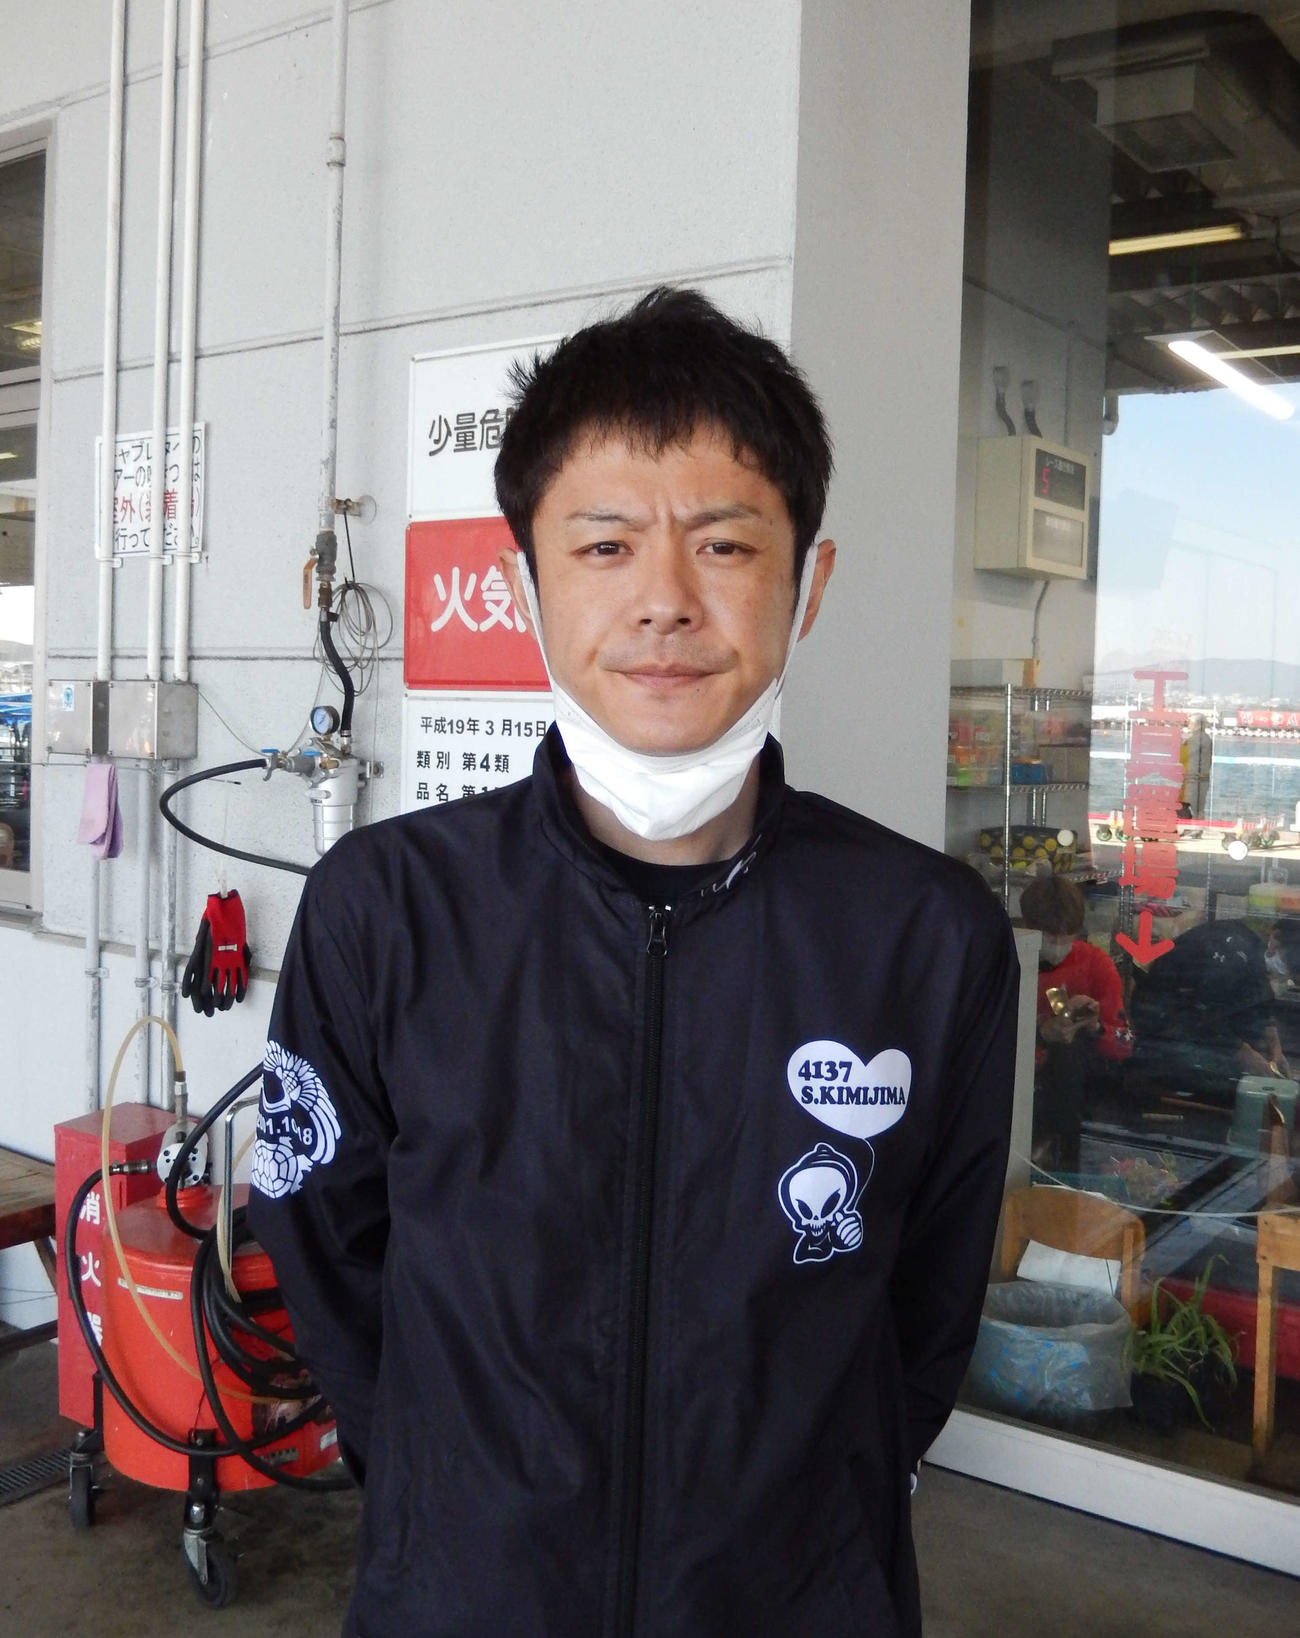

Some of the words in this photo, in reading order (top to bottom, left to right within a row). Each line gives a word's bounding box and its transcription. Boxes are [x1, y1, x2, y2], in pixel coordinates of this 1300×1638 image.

[428, 407, 512, 457] 少量危
[416, 750, 450, 770] 類別
[462, 752, 510, 773] 第4類
[416, 782, 449, 802] 品名
[798, 1060, 853, 1083] 4137
[801, 1086, 906, 1105] S.KIMIJIMA
